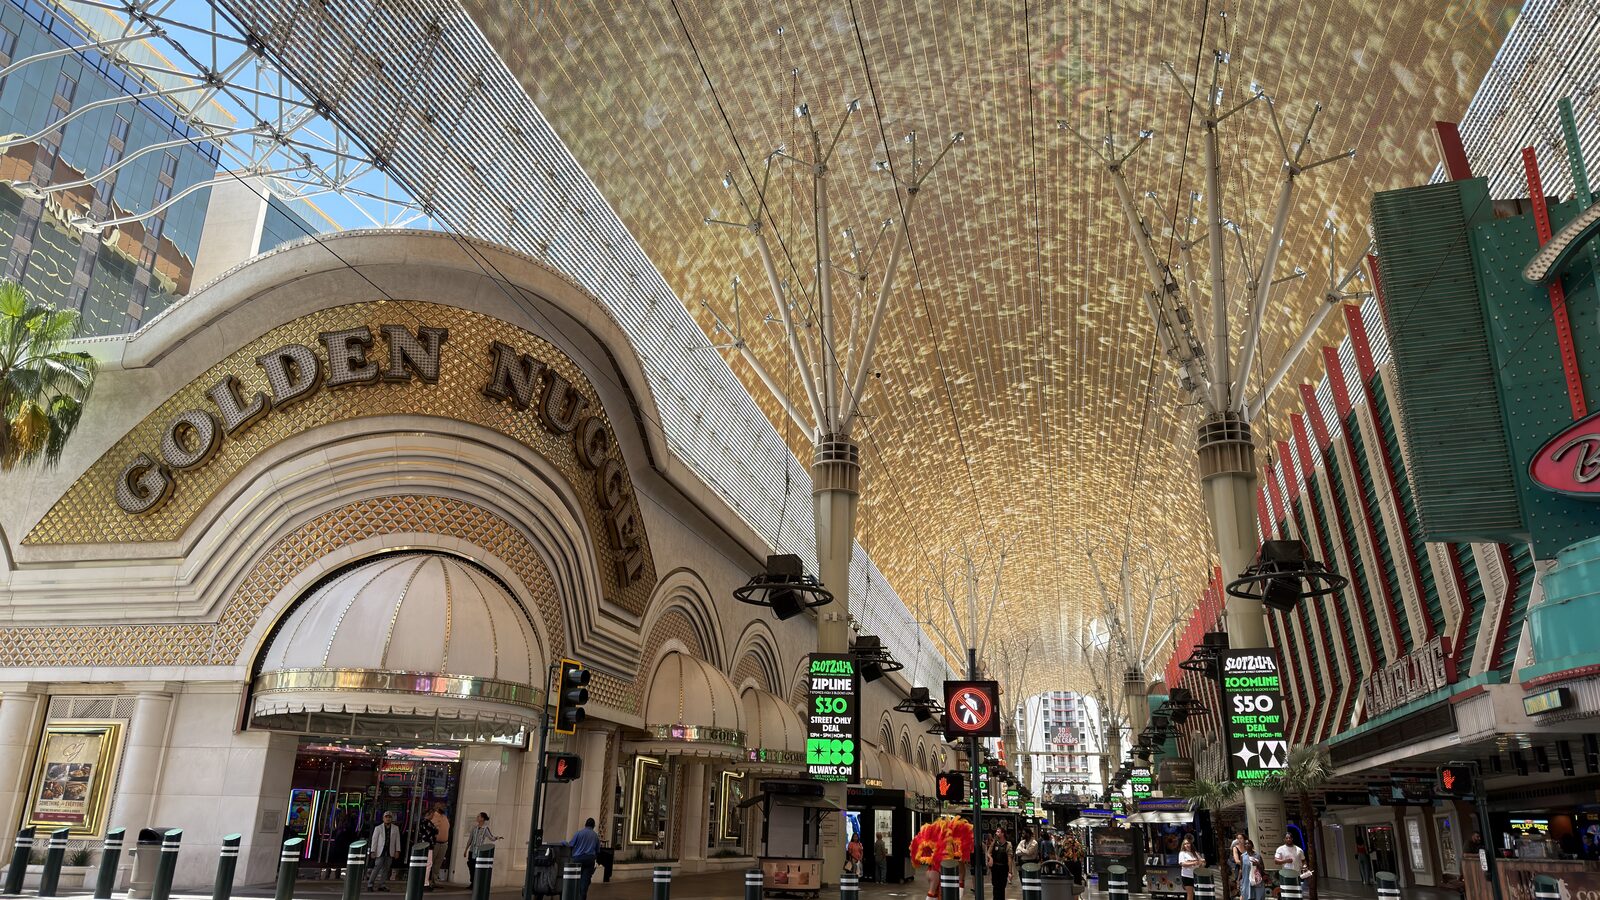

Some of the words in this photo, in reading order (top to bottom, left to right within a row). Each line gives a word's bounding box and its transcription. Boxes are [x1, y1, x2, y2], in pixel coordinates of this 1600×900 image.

[114, 324, 448, 516] GOLDEN
[481, 340, 644, 589] NUGGET
[810, 660, 854, 674] SLOTZILLA
[1224, 655, 1276, 671] SLOTZILLA
[1224, 676, 1279, 688] ZOOMLINE
[1363, 635, 1448, 719] GAMBLING
[811, 678, 852, 691] ZIPLINE
[815, 695, 847, 715] $30
[1233, 693, 1273, 714] $50
[810, 716, 833, 724] STREET
[834, 716, 852, 724] ONLY
[1231, 715, 1257, 724] STREET
[1259, 715, 1279, 723] ONLY
[822, 724, 840, 732] DEAL
[1246, 724, 1267, 732] DEAL
[808, 765, 838, 775] ALWAYS
[839, 766, 852, 775] ON
[1133, 784, 1149, 792] $50
